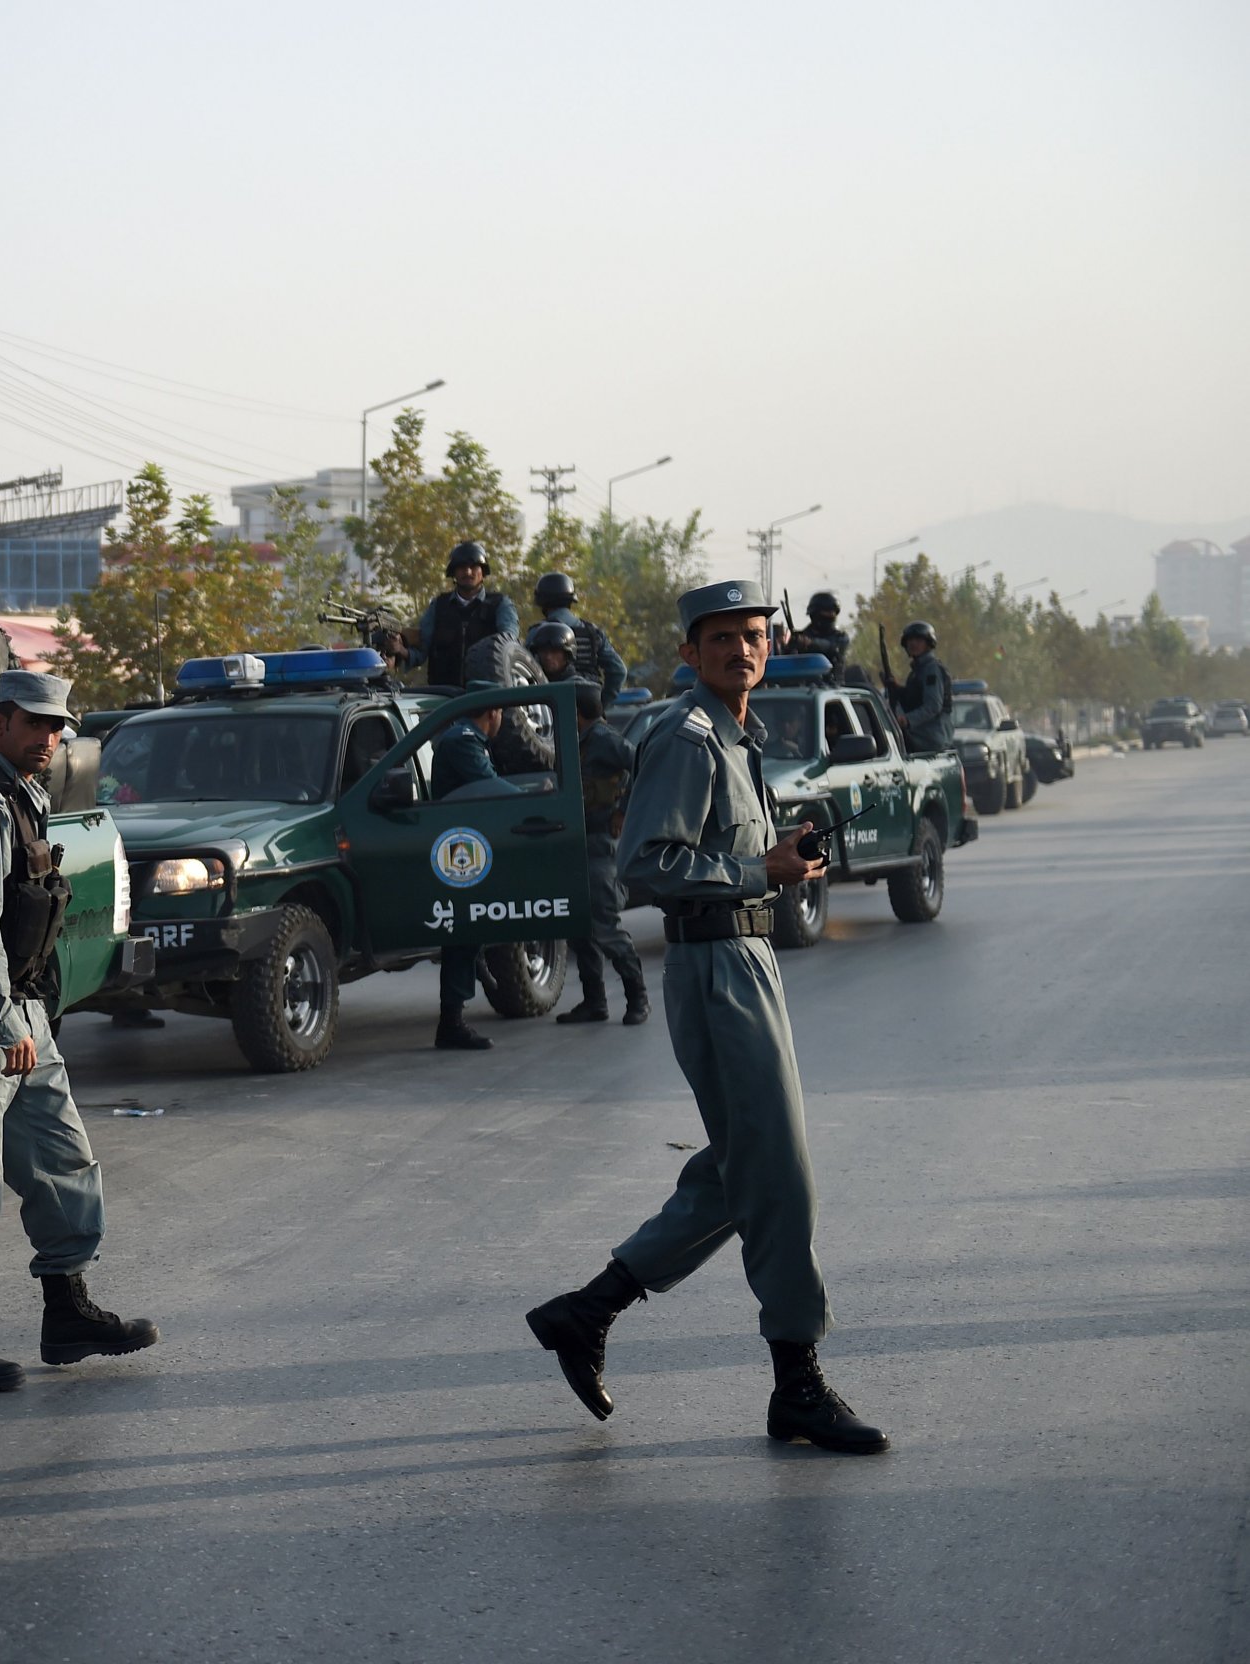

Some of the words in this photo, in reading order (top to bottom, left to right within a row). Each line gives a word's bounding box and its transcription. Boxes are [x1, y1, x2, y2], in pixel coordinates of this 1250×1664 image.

[857, 828, 879, 844] POLICE
[424, 899, 455, 934] پو
[469, 898, 570, 922] POLICE
[144, 923, 195, 950] QRF
